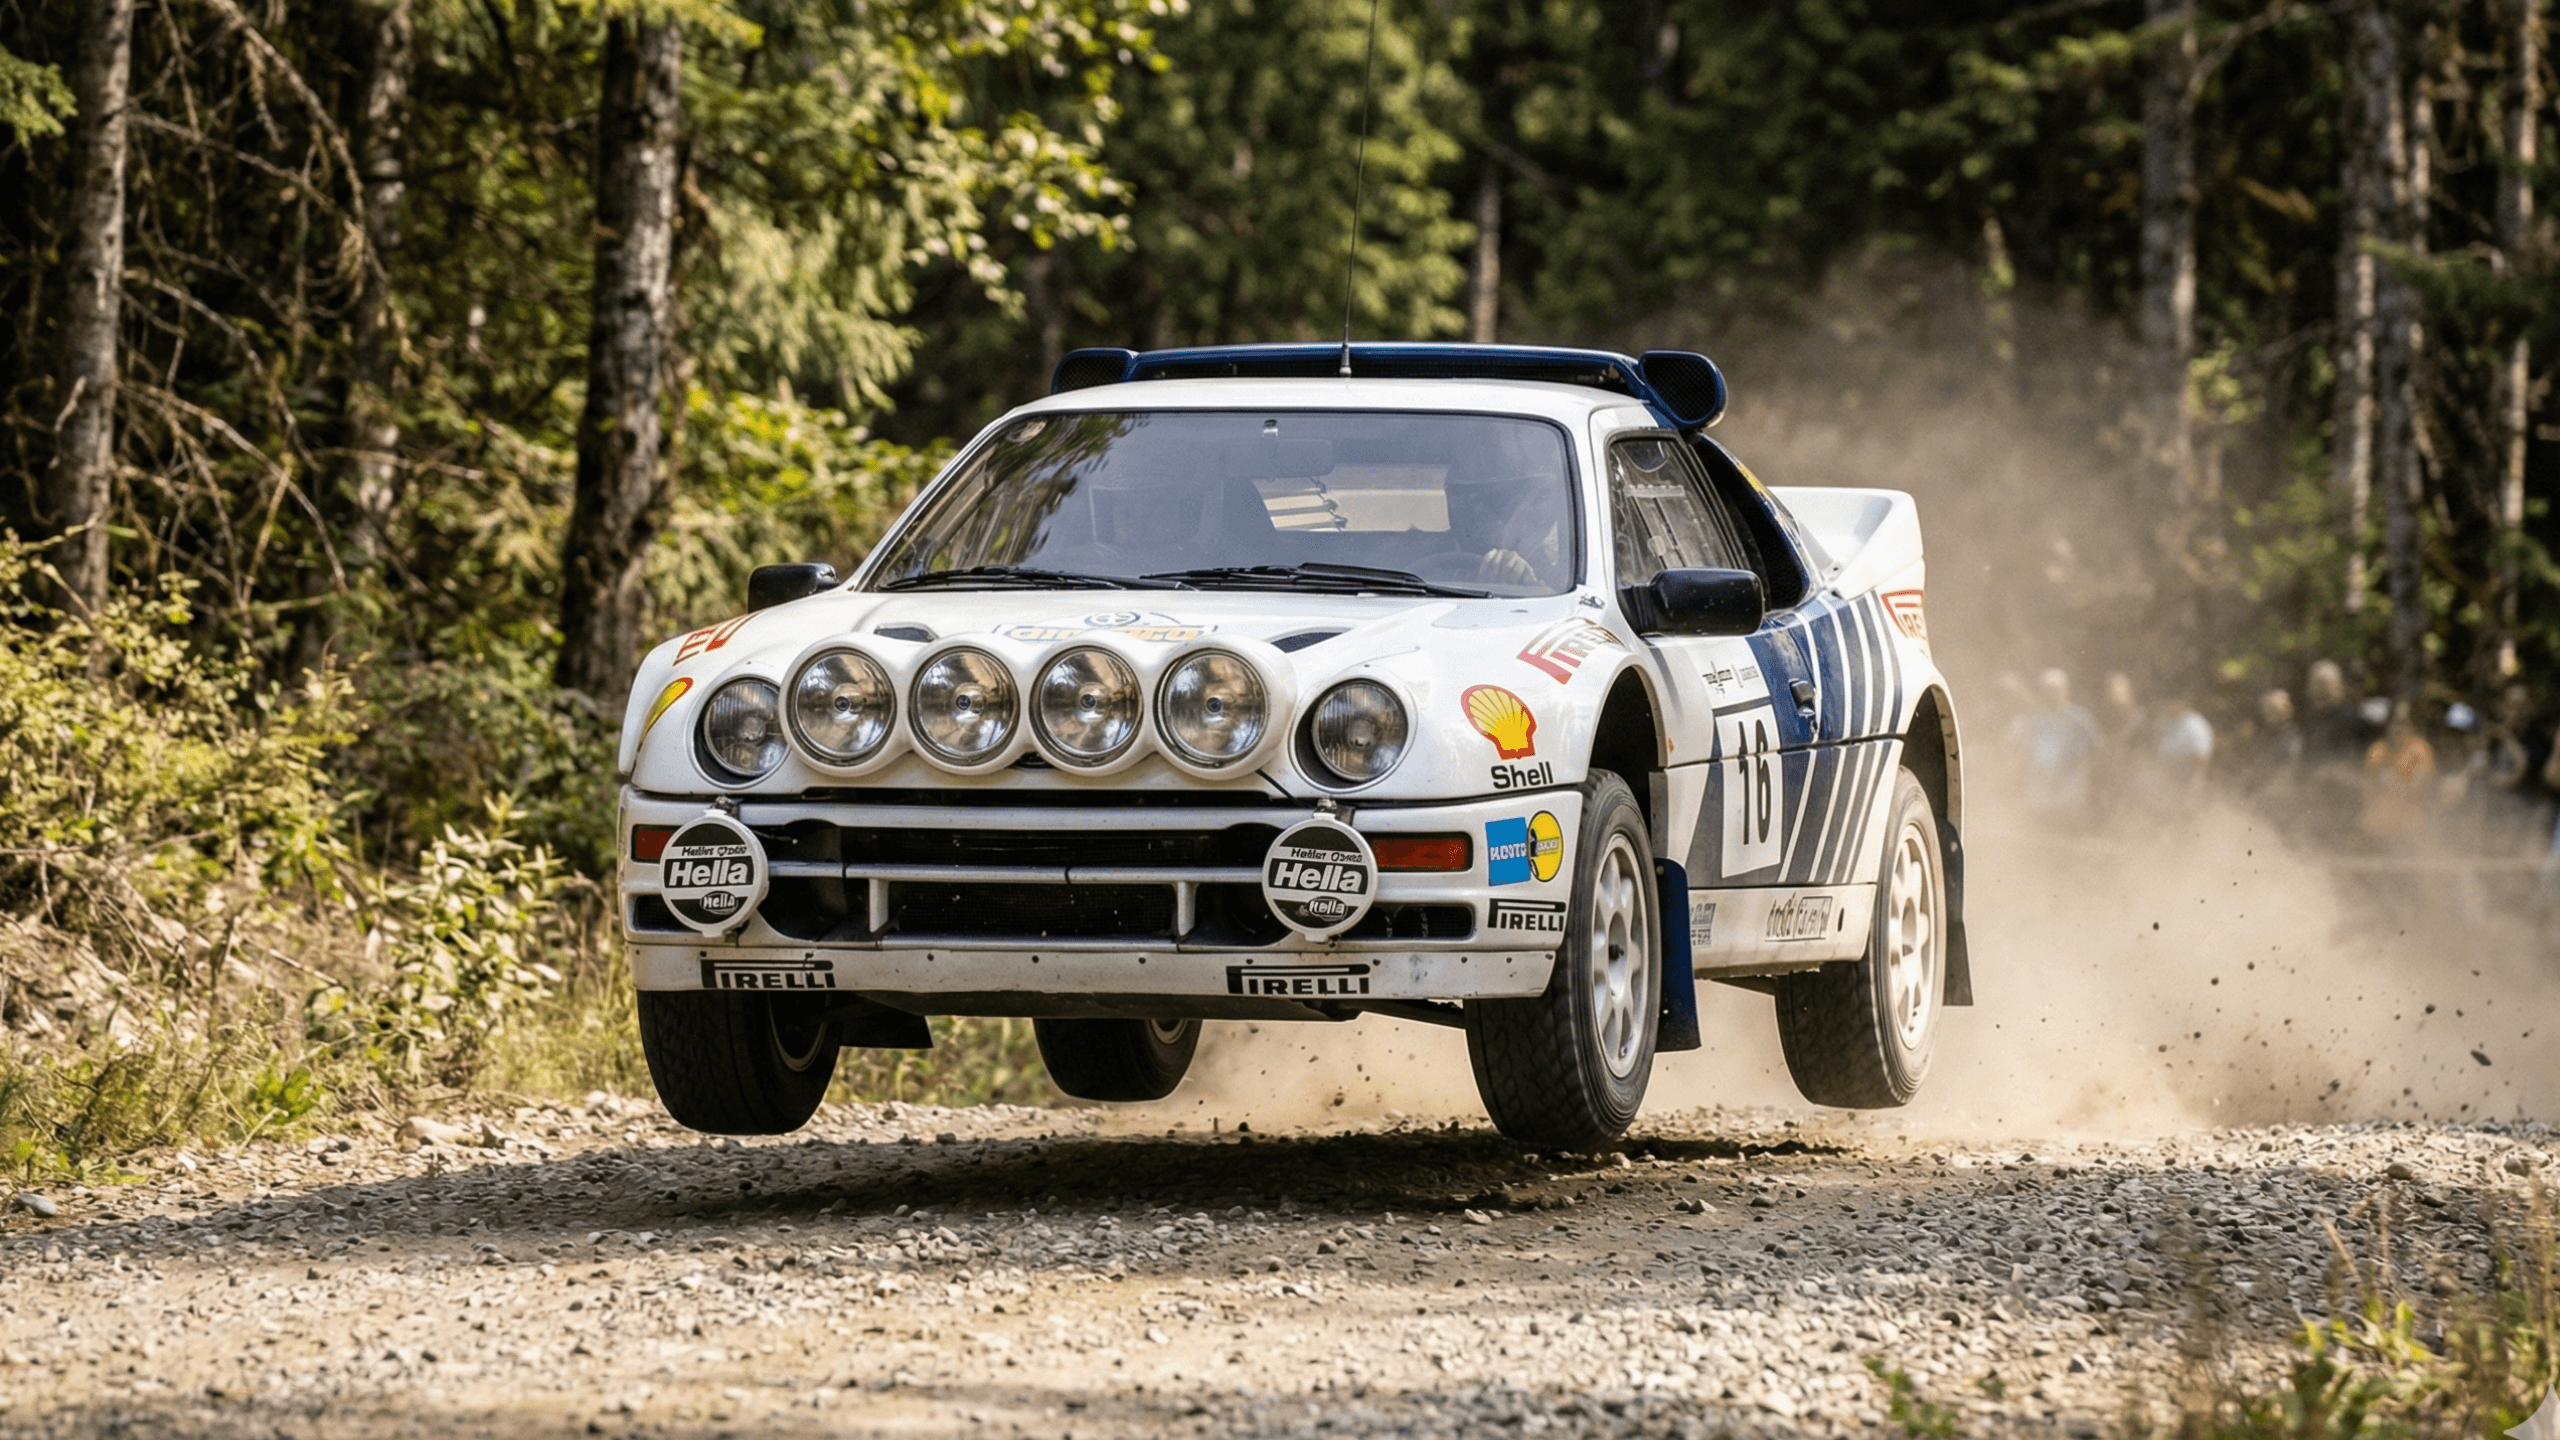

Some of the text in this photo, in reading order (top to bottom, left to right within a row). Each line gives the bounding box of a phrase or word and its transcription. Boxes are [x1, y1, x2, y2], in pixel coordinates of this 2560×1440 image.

[1490, 761, 1554, 790] Shell
[1737, 718, 1772, 846] 16
[669, 859, 748, 887] Hella
[1273, 861, 1363, 892] Hella
[1487, 898, 1567, 932] PIRELLI
[700, 959, 836, 989] PIRELLI
[1226, 964, 1371, 995] PIRELLI
